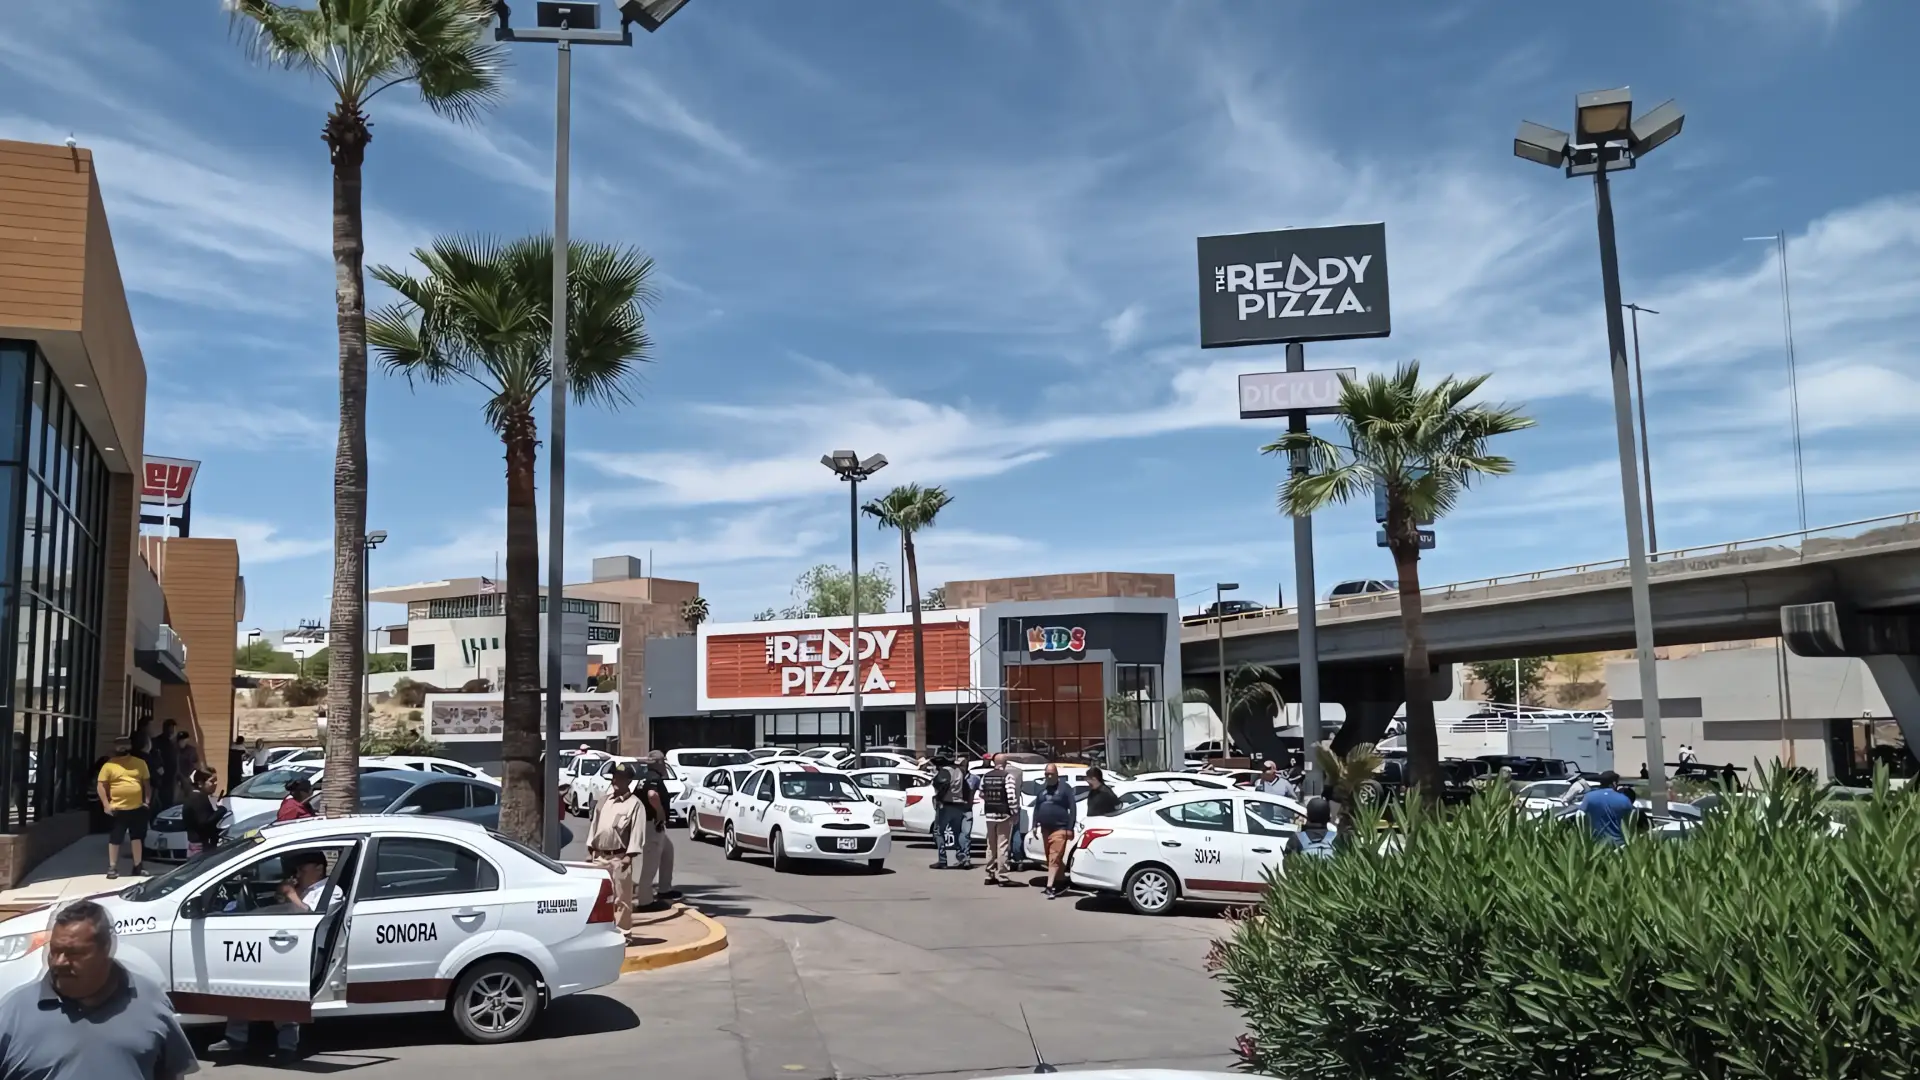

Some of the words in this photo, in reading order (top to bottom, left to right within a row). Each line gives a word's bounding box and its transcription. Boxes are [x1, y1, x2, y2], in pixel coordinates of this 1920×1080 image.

[1215, 265, 1225, 293] THE
[1226, 253, 1372, 292] READY
[1237, 287, 1366, 320] PIZZA
[765, 636, 774, 664] THE
[774, 629, 897, 668] READY
[1026, 625, 1087, 653] KIDS
[376, 922, 438, 944] SONORA
[223, 940, 262, 963] TAXI
